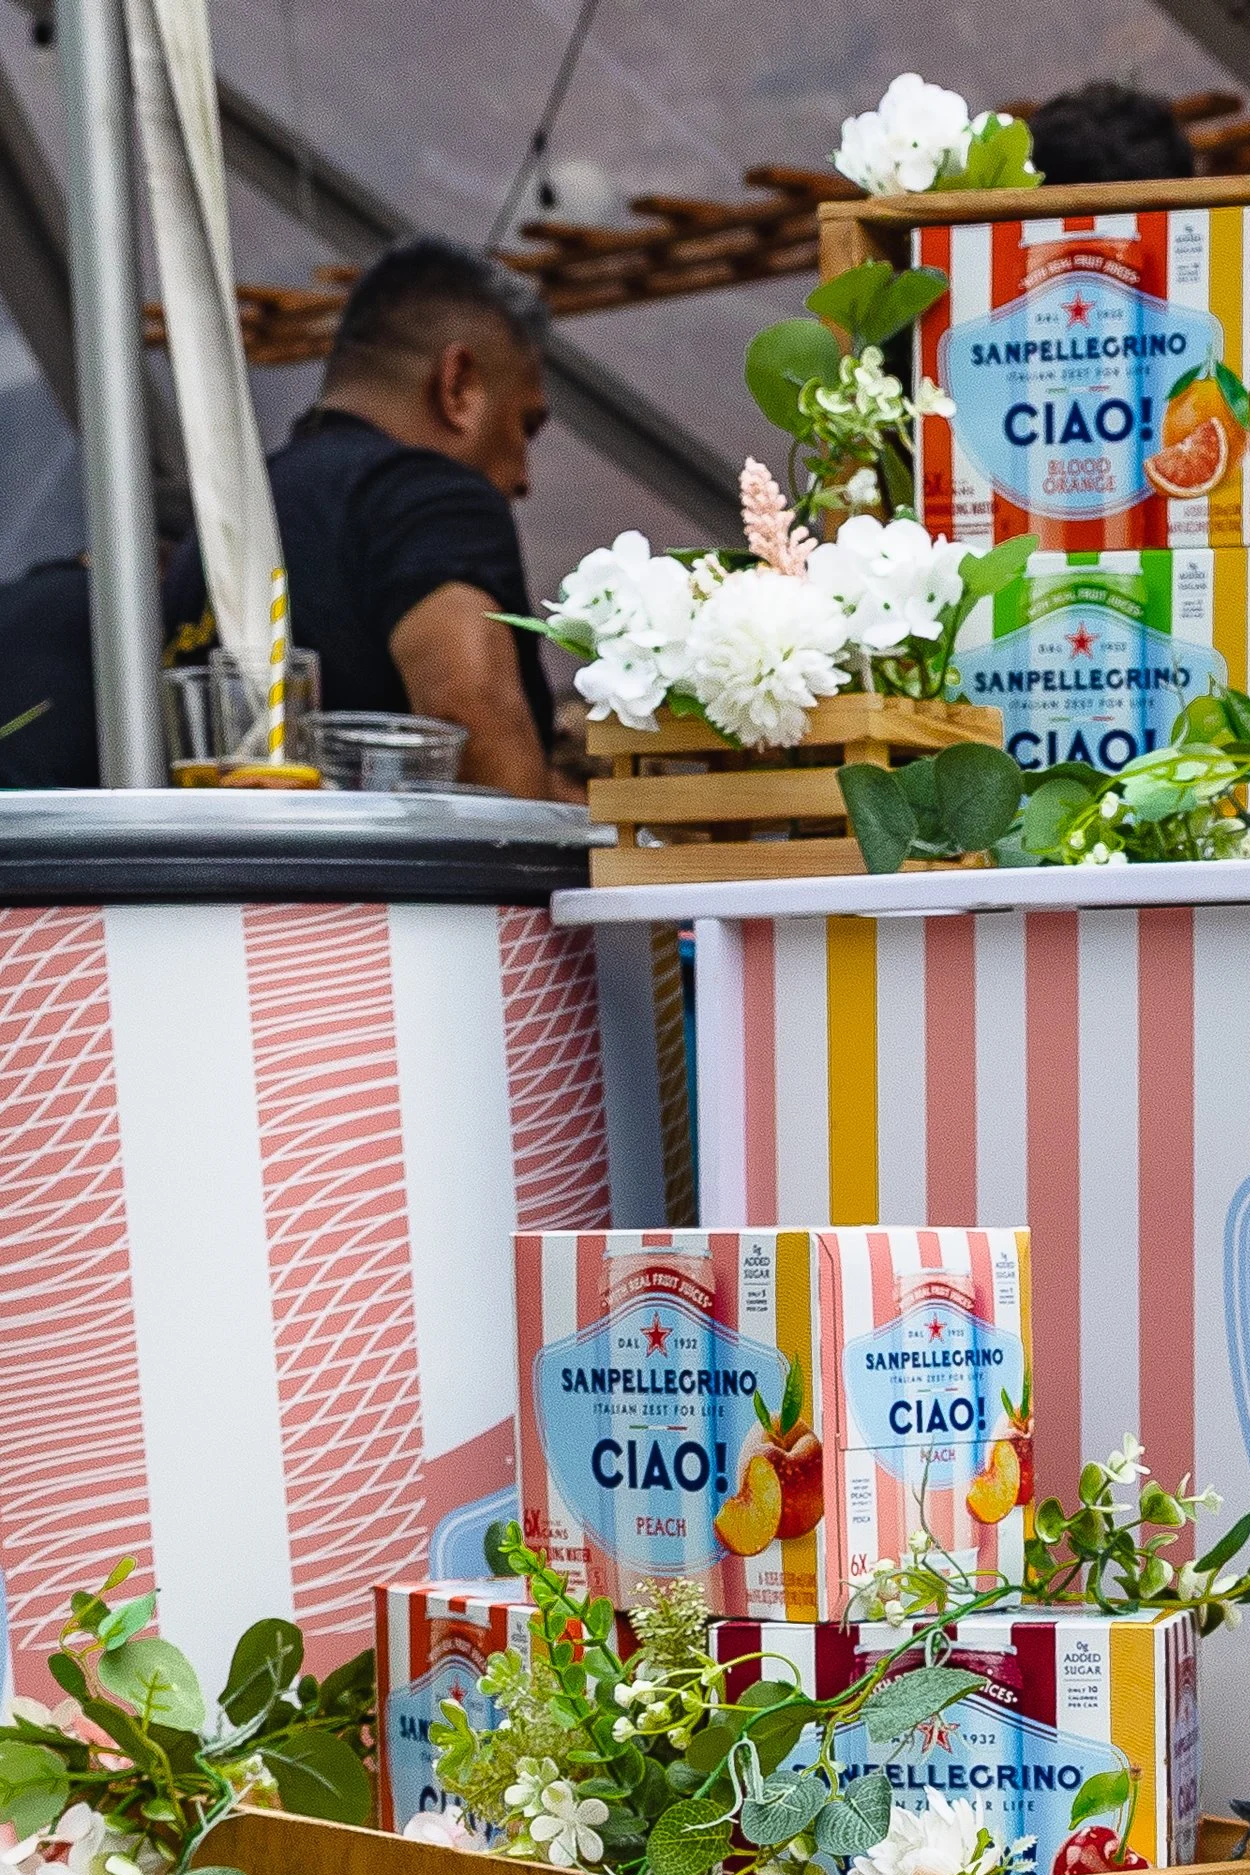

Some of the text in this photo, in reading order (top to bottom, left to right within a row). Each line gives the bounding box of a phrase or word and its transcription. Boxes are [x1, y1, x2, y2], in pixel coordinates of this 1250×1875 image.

[1004, 397, 1153, 447] CIAO!
[1042, 475, 1116, 495] ORANGE
[617, 1338, 640, 1350] DAL
[865, 1348, 1004, 1371] SANPELLEGRINO
[561, 1366, 758, 1397] SANPELLEGRINO
[889, 1396, 986, 1435] CIAO!
[591, 1437, 728, 1494] CIAO!
[635, 1515, 688, 1537] PEACH
[851, 1553, 868, 1577] 6X
[1064, 1653, 1101, 1663] ADDED
[1064, 1665, 1102, 1675] SUGAR
